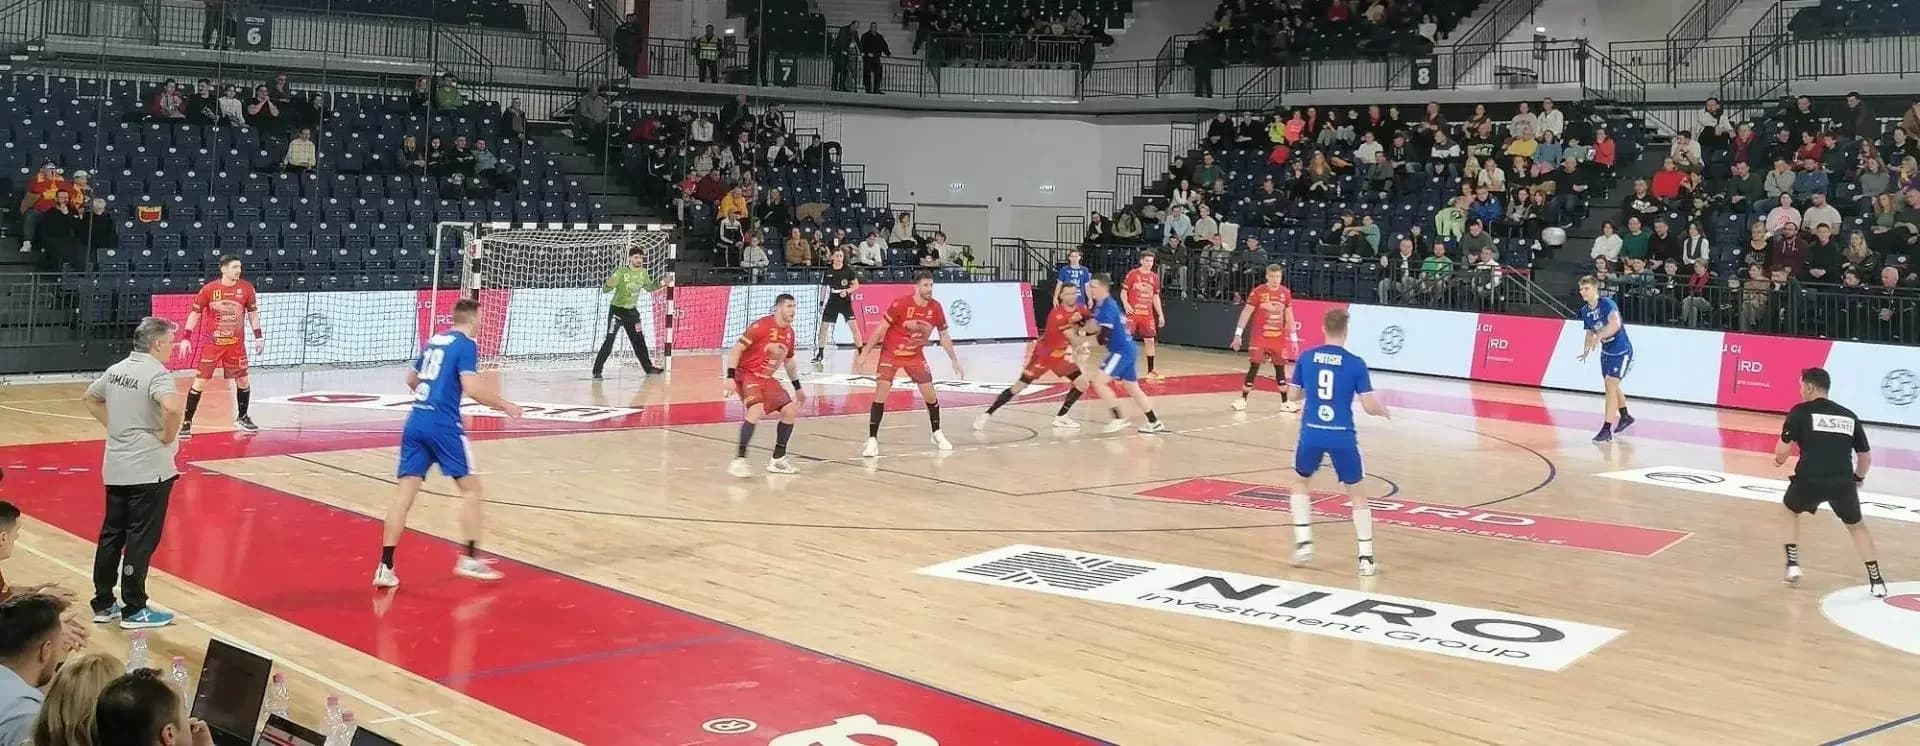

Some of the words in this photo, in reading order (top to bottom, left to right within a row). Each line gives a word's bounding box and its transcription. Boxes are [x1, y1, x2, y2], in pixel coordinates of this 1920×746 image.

[247, 27, 261, 45] 6
[782, 66, 791, 81] 7
[1417, 67, 1430, 85] 8
[1488, 338, 1509, 349] RD
[420, 347, 445, 380] 18
[1738, 360, 1763, 373] RD
[1318, 369, 1335, 400] 9
[1166, 575, 1566, 643] NIRO
[1137, 592, 1371, 634] Investment
[1385, 629, 1531, 660] Group
